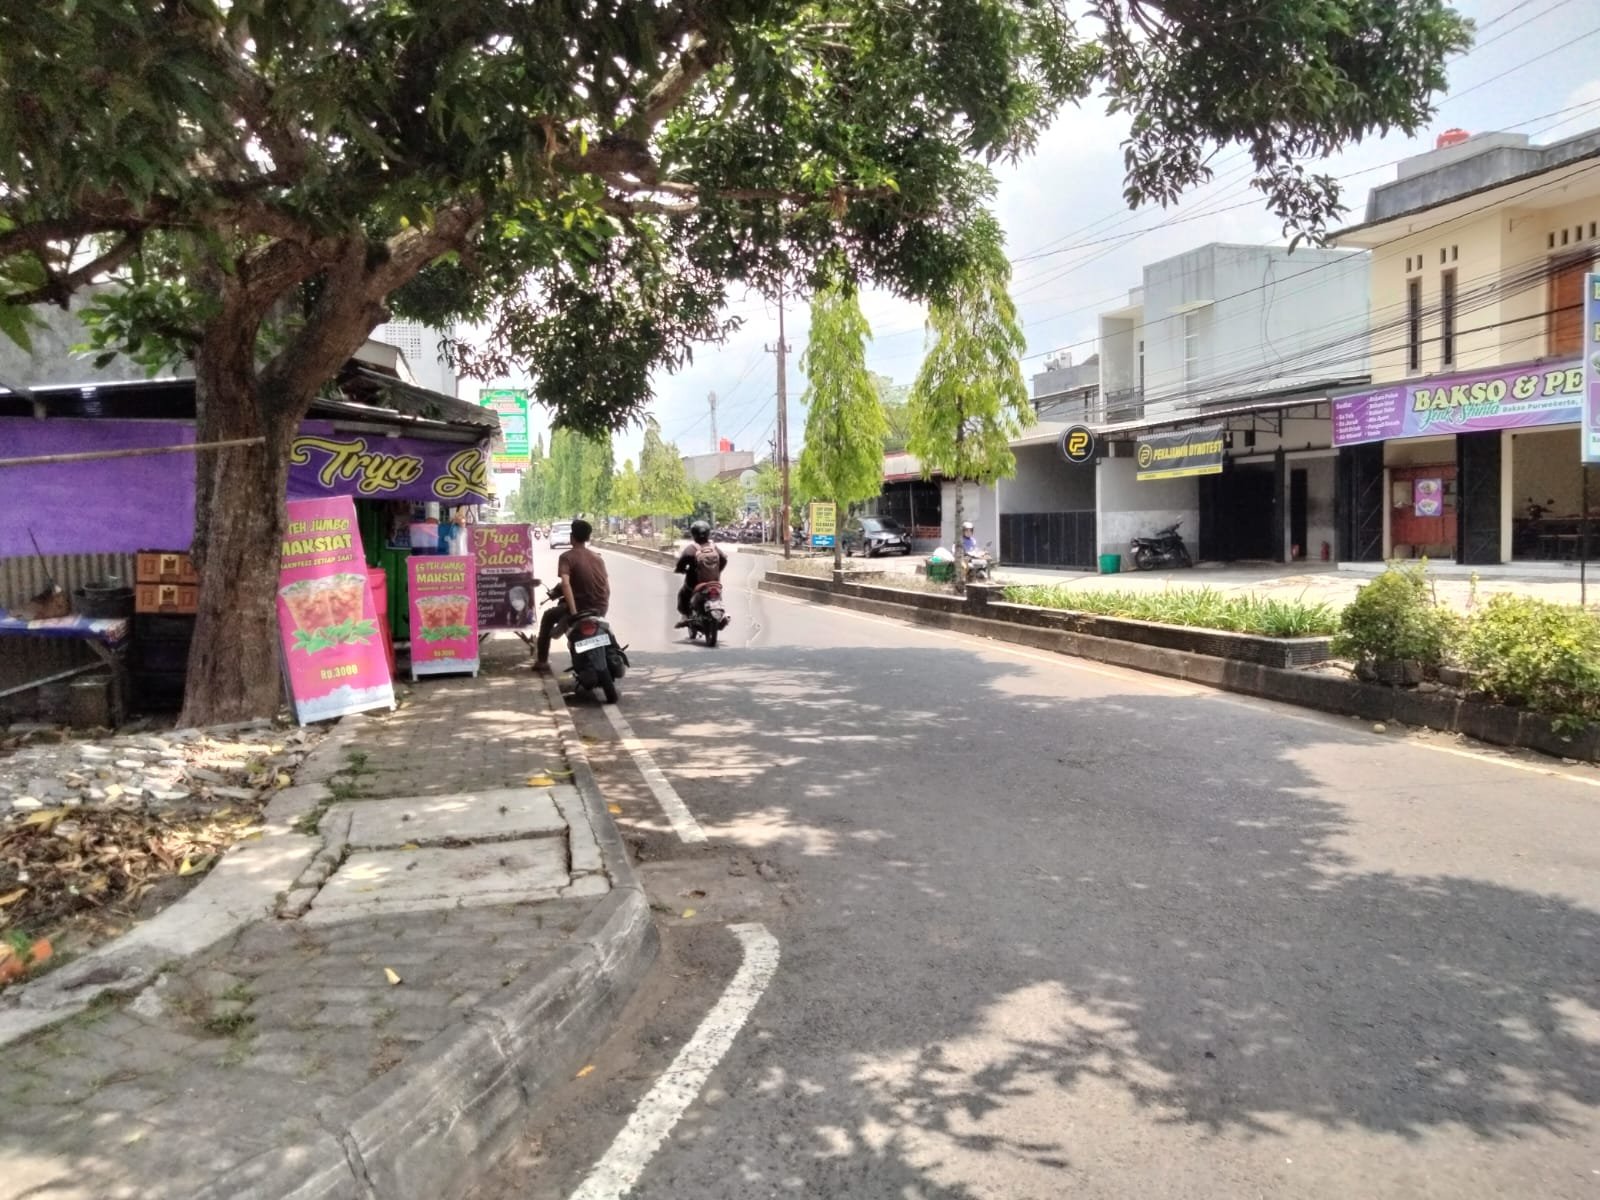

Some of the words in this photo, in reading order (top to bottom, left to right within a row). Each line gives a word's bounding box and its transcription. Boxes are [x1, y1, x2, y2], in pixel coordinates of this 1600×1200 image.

[1413, 379, 1508, 412] BAKSO
[1511, 374, 1540, 400] &
[290, 436, 424, 494] Trya
[288, 521, 307, 535] TEH
[310, 519, 350, 532] JUMBO
[474, 528, 519, 548] Trya
[475, 548, 526, 567] Salon
[416, 572, 466, 584] MAKSIAT
